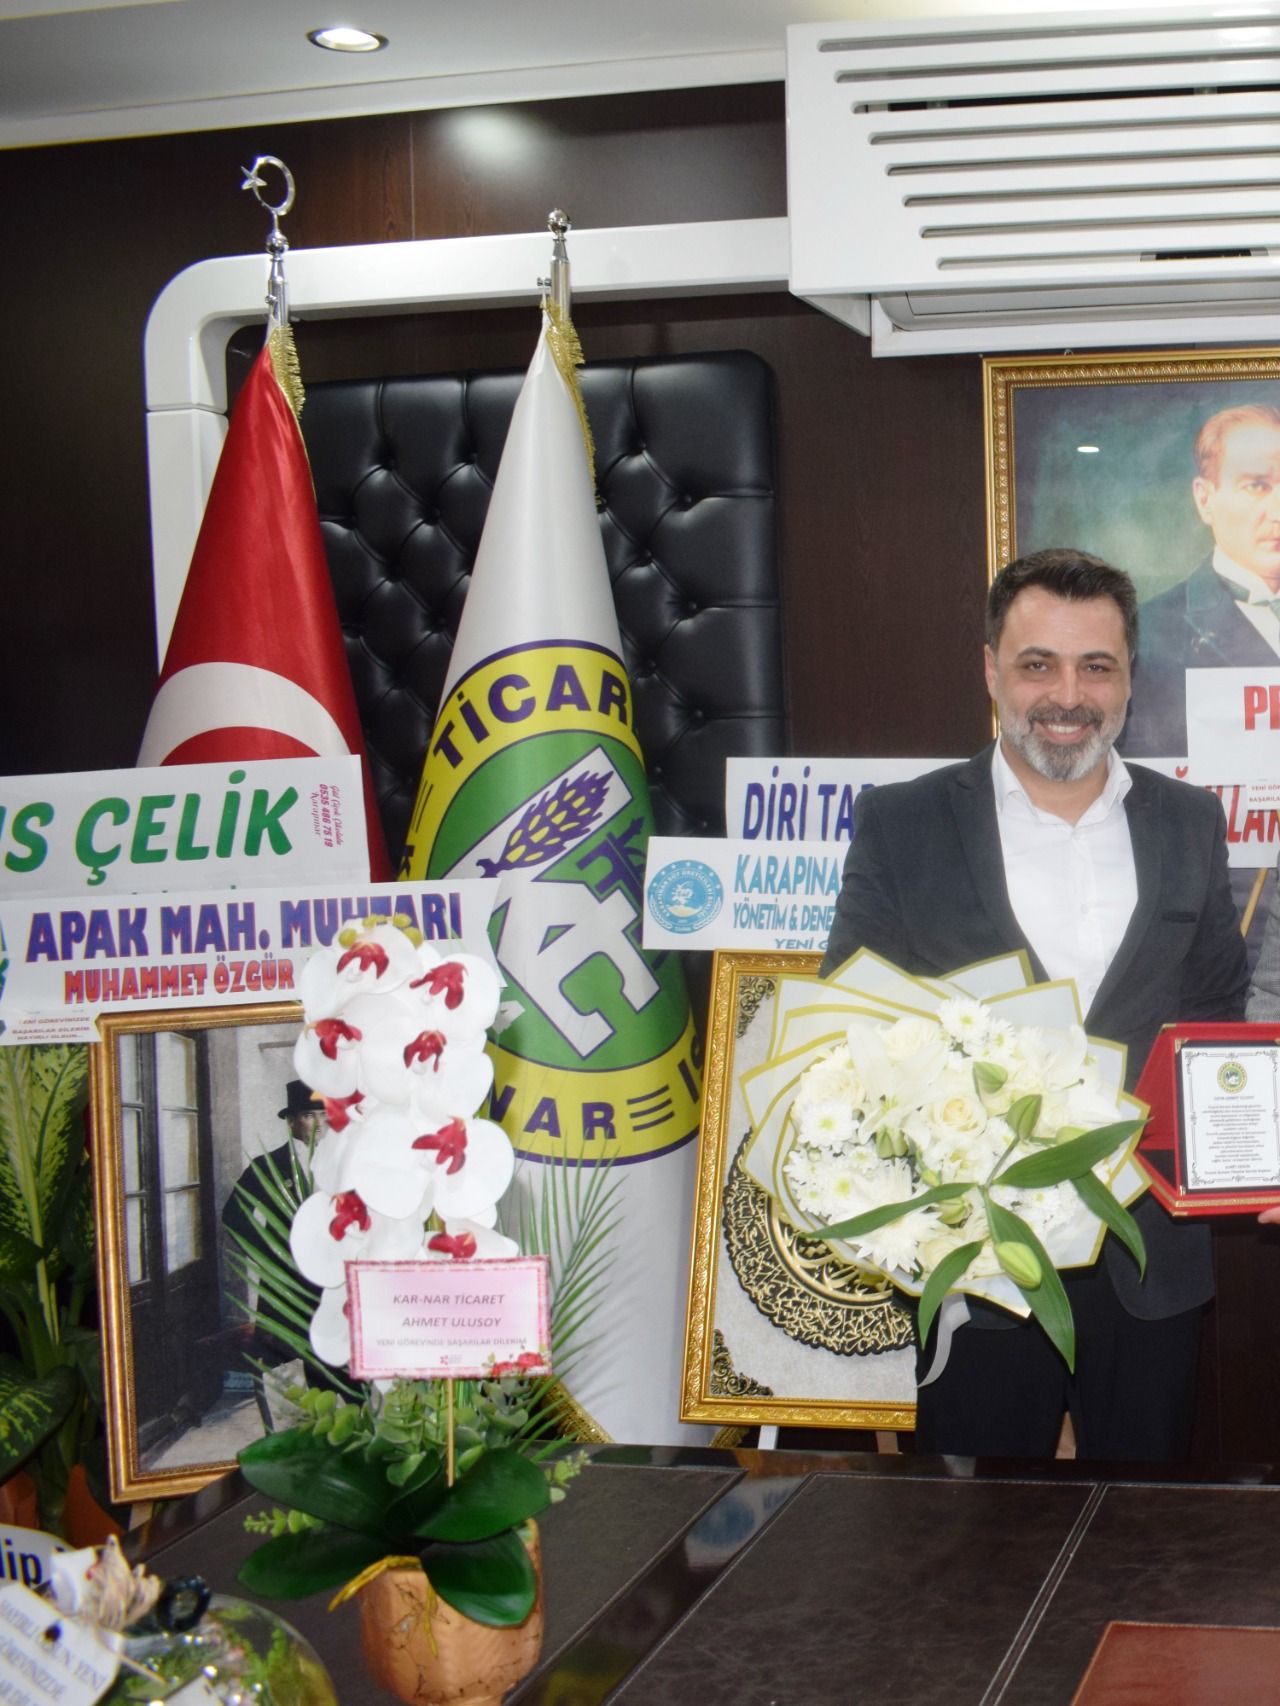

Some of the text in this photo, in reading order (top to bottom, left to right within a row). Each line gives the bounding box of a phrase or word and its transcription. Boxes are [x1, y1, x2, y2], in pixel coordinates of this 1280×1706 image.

[433, 664, 628, 770] TİCAR
[742, 765, 876, 841] DİRİ TA
[0, 769, 299, 886] S ÇELİK
[734, 854, 843, 896] KARAPINA
[25, 908, 149, 963] APAK
[160, 902, 270, 955] MAH.
[733, 896, 837, 931] YÖNETİM & DENE
[774, 936, 814, 950] YENİ
[64, 952, 295, 1004] MUHAMMET ÖZGÜR
[392, 1292, 506, 1305] KAR-NAR TİCARET
[401, 1317, 502, 1328] AHMET ULUSOY
